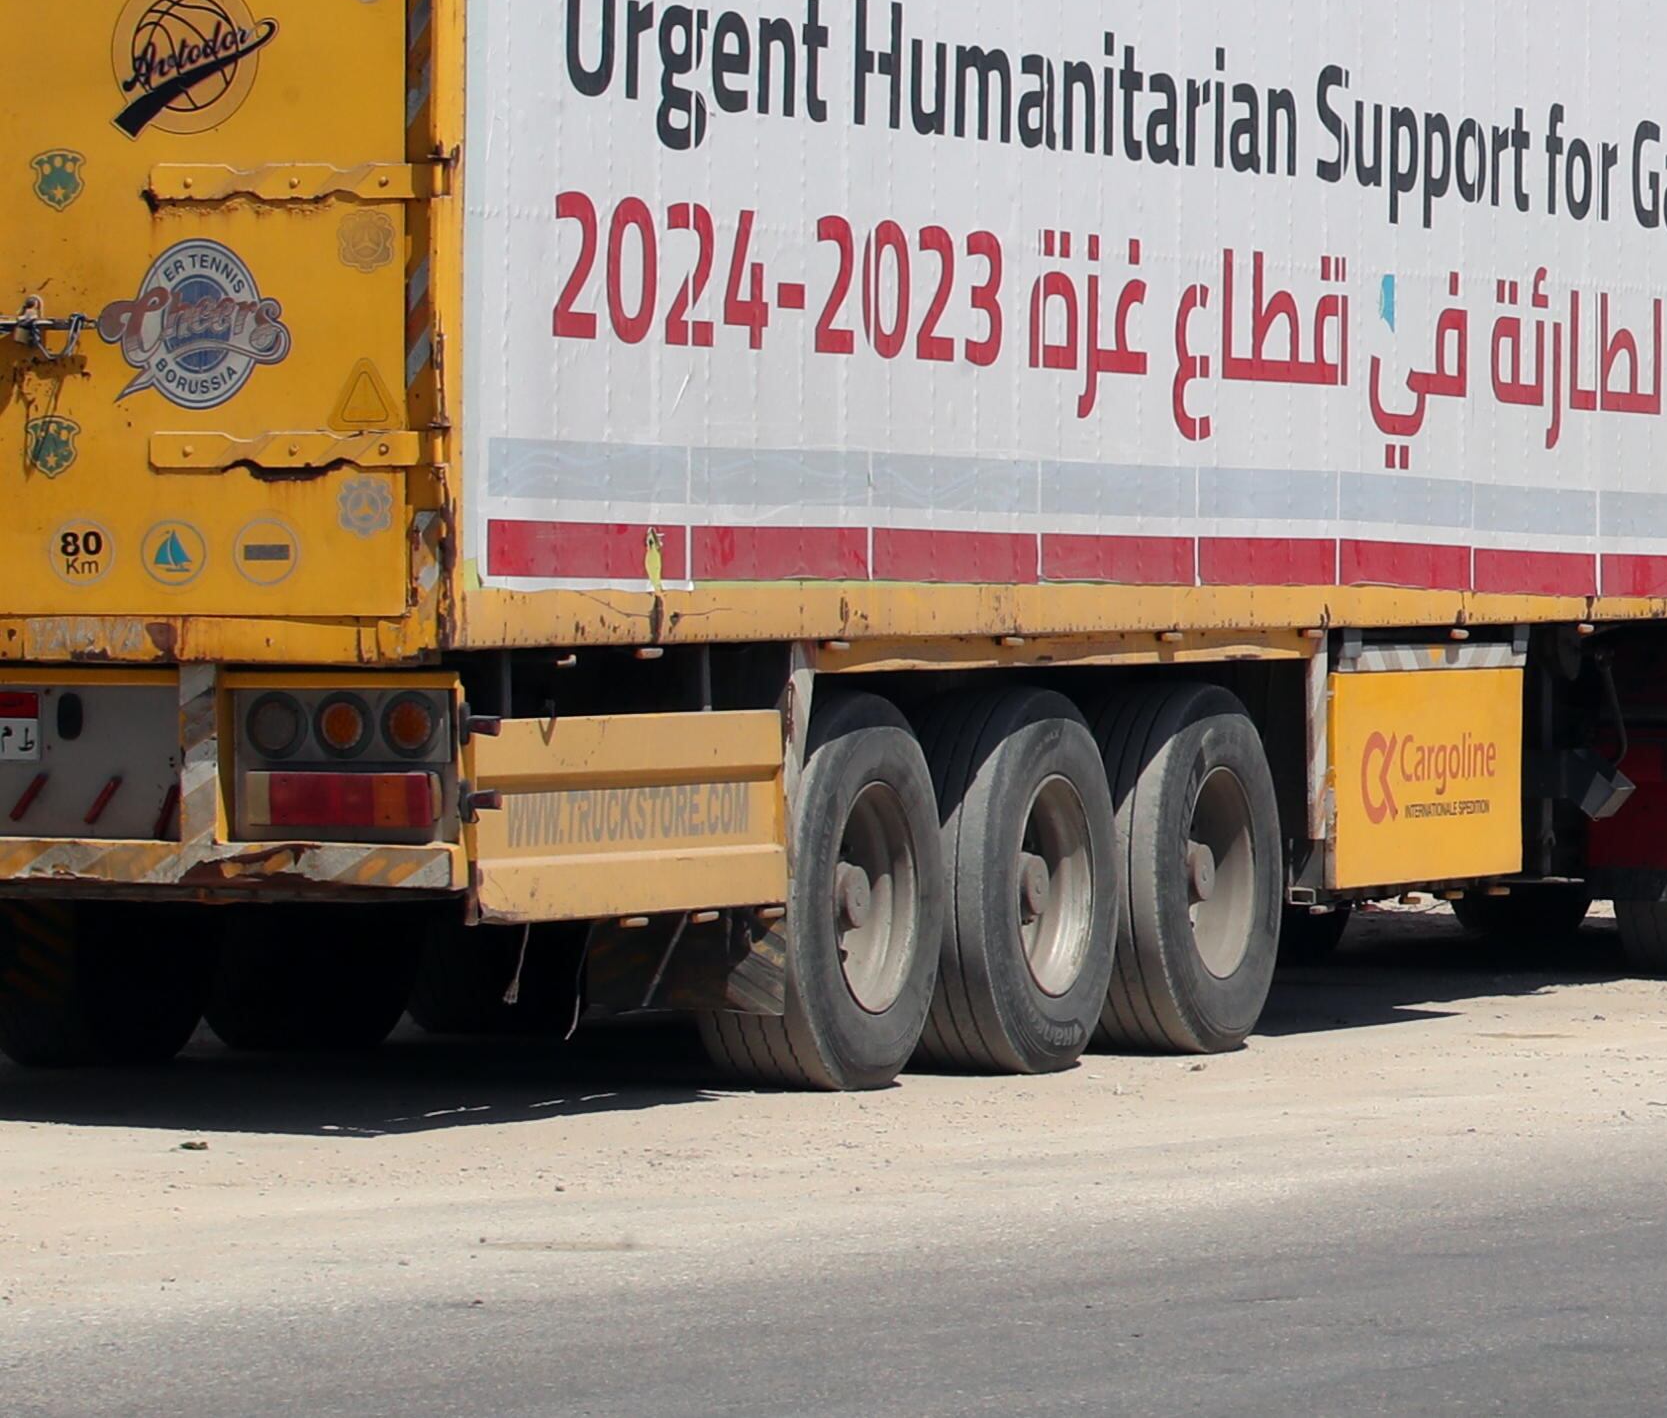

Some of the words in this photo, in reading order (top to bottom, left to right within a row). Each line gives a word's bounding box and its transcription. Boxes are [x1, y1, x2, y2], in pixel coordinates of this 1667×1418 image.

[1316, 64, 1530, 229] Support
[1544, 103, 1618, 222] for
[187, 253, 246, 295] TENNIS
[99, 286, 288, 364] Cheers
[1028, 229, 1148, 418] غزة
[1172, 247, 1349, 441] قطاع
[155, 357, 239, 395] BORUSSIA
[1369, 272, 1468, 470] في
[61, 530, 103, 557] 80
[66, 556, 100, 575] Km
[1400, 731, 1497, 796] Cargoline
[506, 781, 750, 848] WWW.TRUCKSTORE.COM
